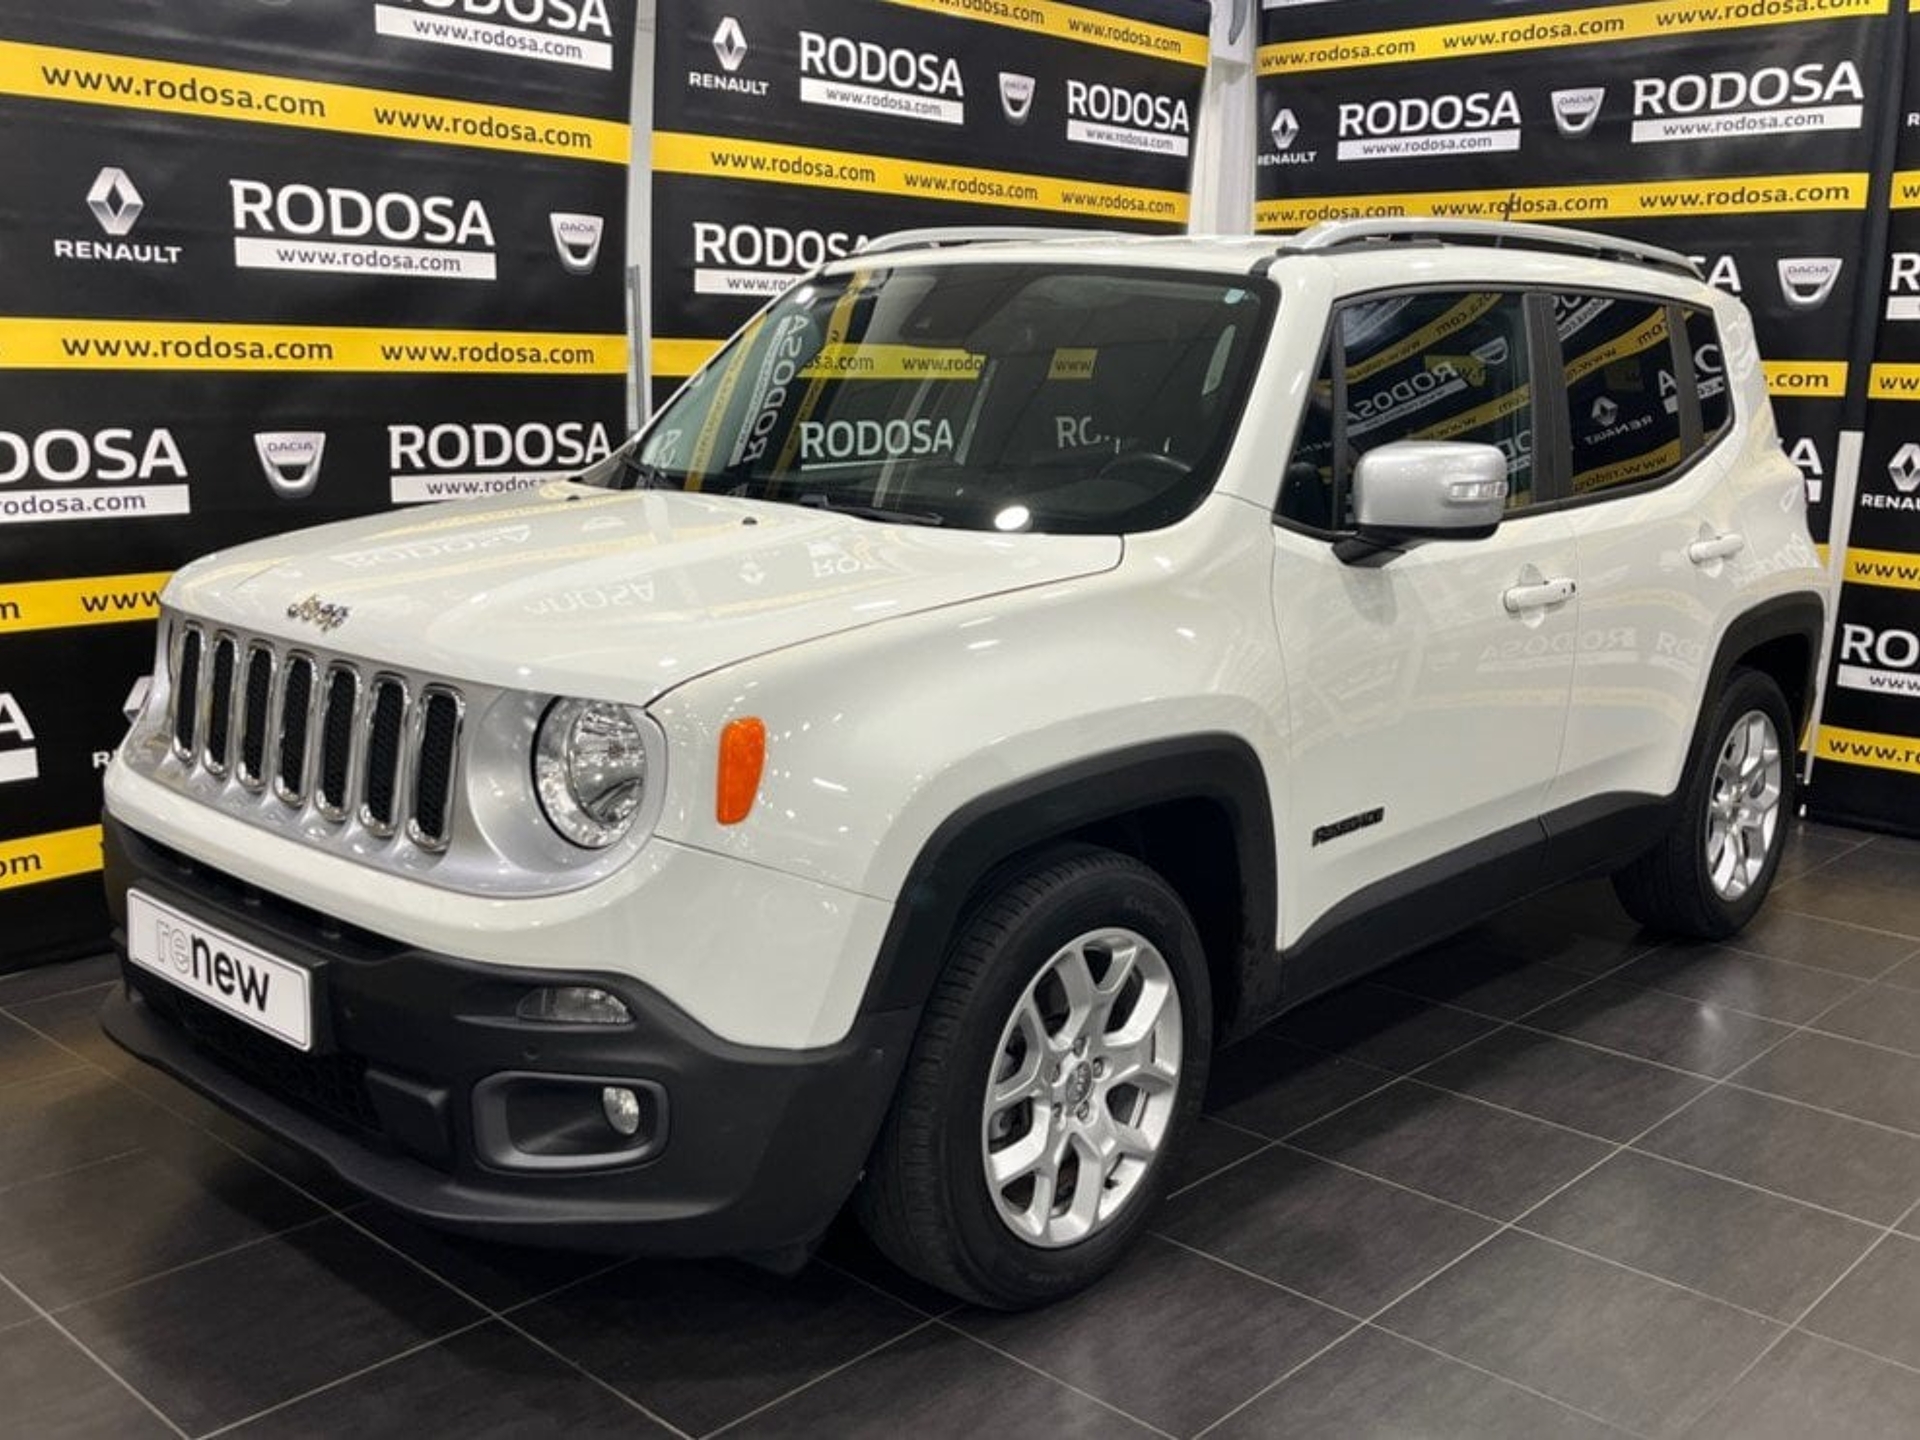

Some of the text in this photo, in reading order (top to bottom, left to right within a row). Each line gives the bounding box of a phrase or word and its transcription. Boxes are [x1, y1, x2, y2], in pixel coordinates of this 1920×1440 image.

[413, 19, 583, 59] www.rodosa.com
[1068, 16, 1181, 53] www.rodosa.com
[1262, 41, 1415, 67] www.rodosa.com
[1443, 18, 1624, 48] www.rodosa.com
[689, 71, 769, 95] RENAULT
[800, 31, 964, 97] RODOSA
[42, 66, 592, 148] www.rodosa.com www.rodosa.com
[825, 88, 942, 117] www.rodosa.com
[1067, 80, 1190, 133] RODOSA
[1633, 61, 1864, 116] RODOSA
[1339, 90, 1521, 137] RODOSA
[1663, 112, 1825, 136] www.rodosa.com
[1086, 127, 1173, 150] www.rodosa.com
[1363, 136, 1492, 155] www.rodosa.com
[711, 151, 1176, 216] www.rodosa.com www.rodosa.com www.rodosa.com
[1639, 183, 1850, 208] www.rodosa.com
[229, 179, 495, 246] RODOSA
[54, 239, 182, 263] RENAULT
[277, 248, 461, 273] www.rodosa.com
[62, 335, 595, 365] www.rodosa.com www.rodosa.com
[387, 422, 612, 470] RODOSA
[800, 418, 955, 459] RODOSA
[0, 493, 146, 515] odosa.com
[156, 919, 269, 1012] renew
